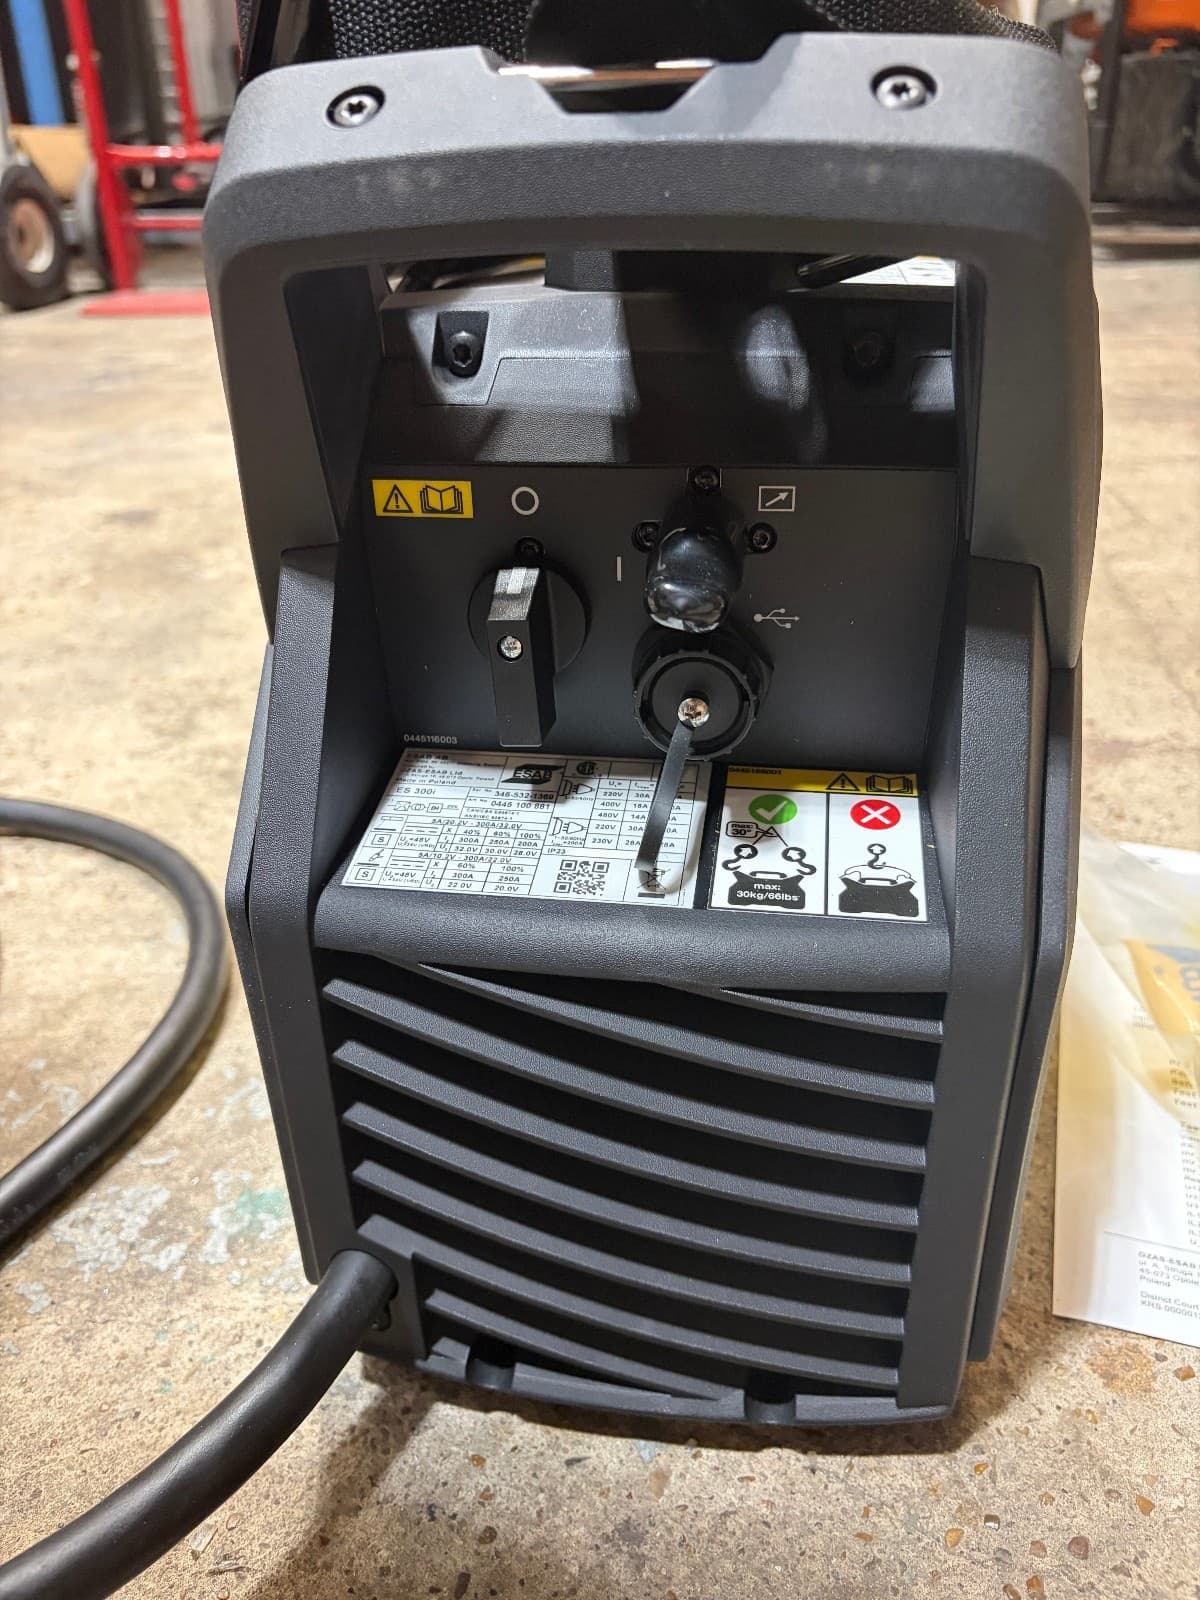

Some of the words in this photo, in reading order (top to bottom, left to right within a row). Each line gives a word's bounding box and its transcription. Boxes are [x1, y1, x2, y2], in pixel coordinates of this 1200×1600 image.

[513, 768, 553, 779] ESAB
[414, 788, 436, 796] 300i
[361, 870, 369, 878] S
[493, 884, 519, 892] 20.0V
[753, 883, 782, 891] max:
[736, 890, 800, 902] 30kg/66lbs
